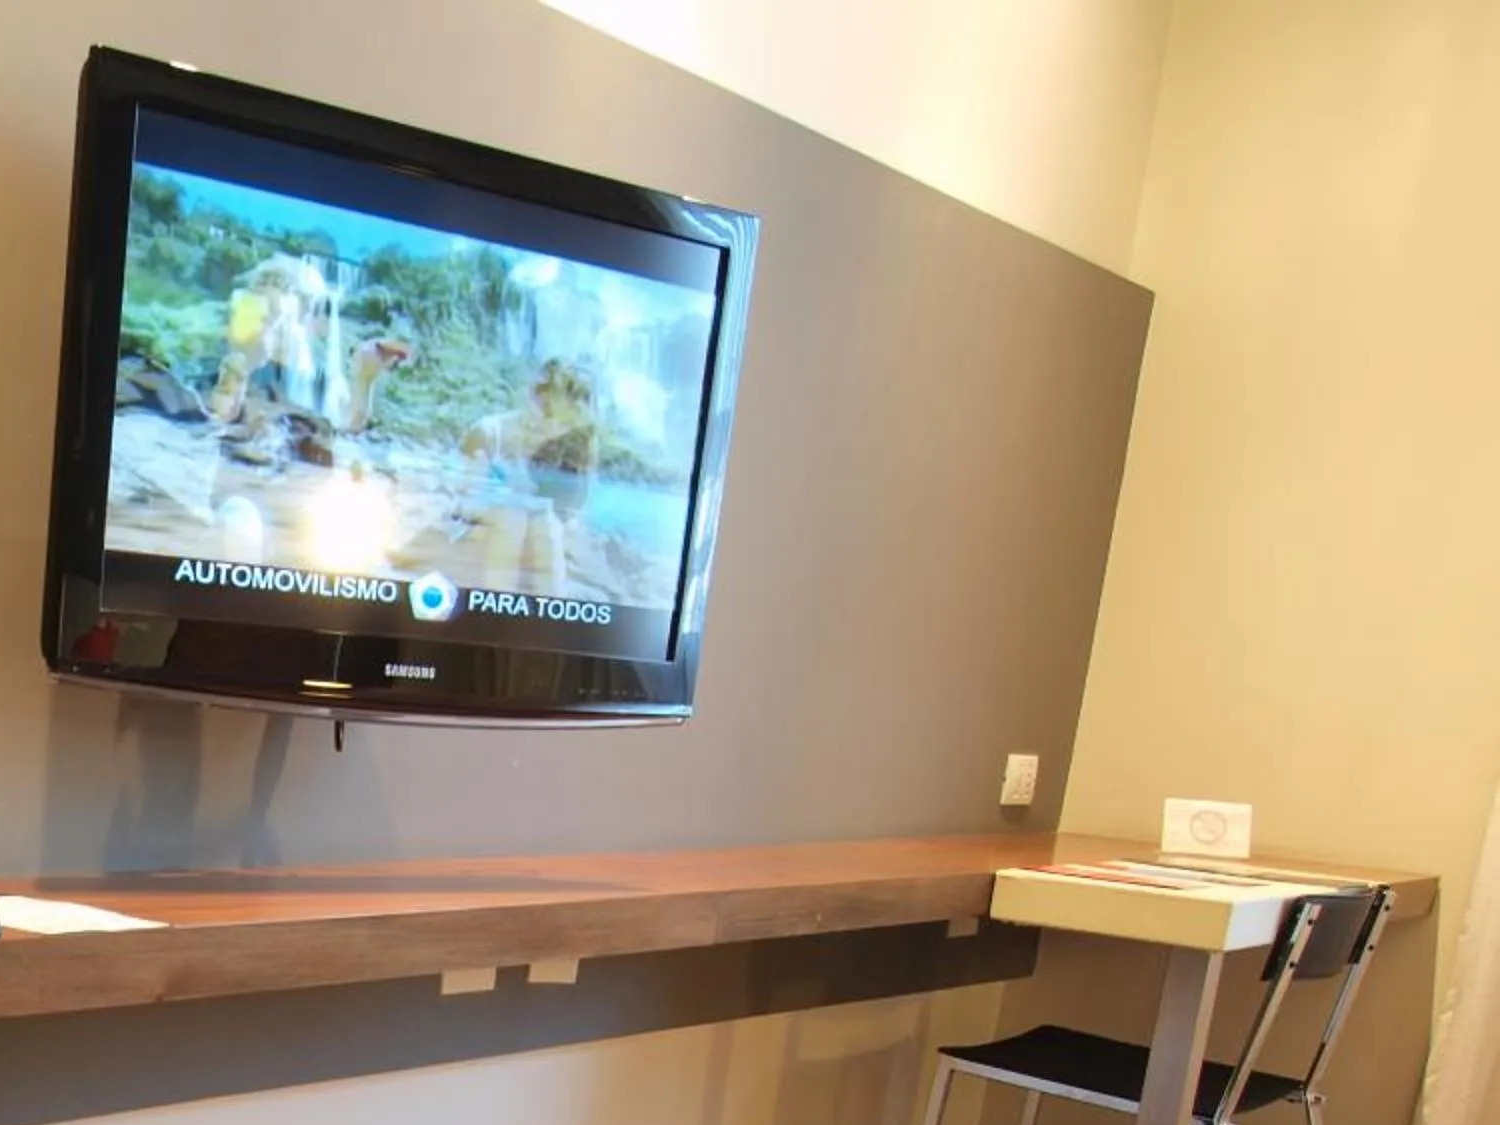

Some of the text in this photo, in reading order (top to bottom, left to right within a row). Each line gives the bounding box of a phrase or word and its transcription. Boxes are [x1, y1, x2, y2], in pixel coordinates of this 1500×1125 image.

[175, 558, 612, 624] AUTOMOVILISMO PARA TODOS
[384, 663, 437, 680] SAMSUNG
